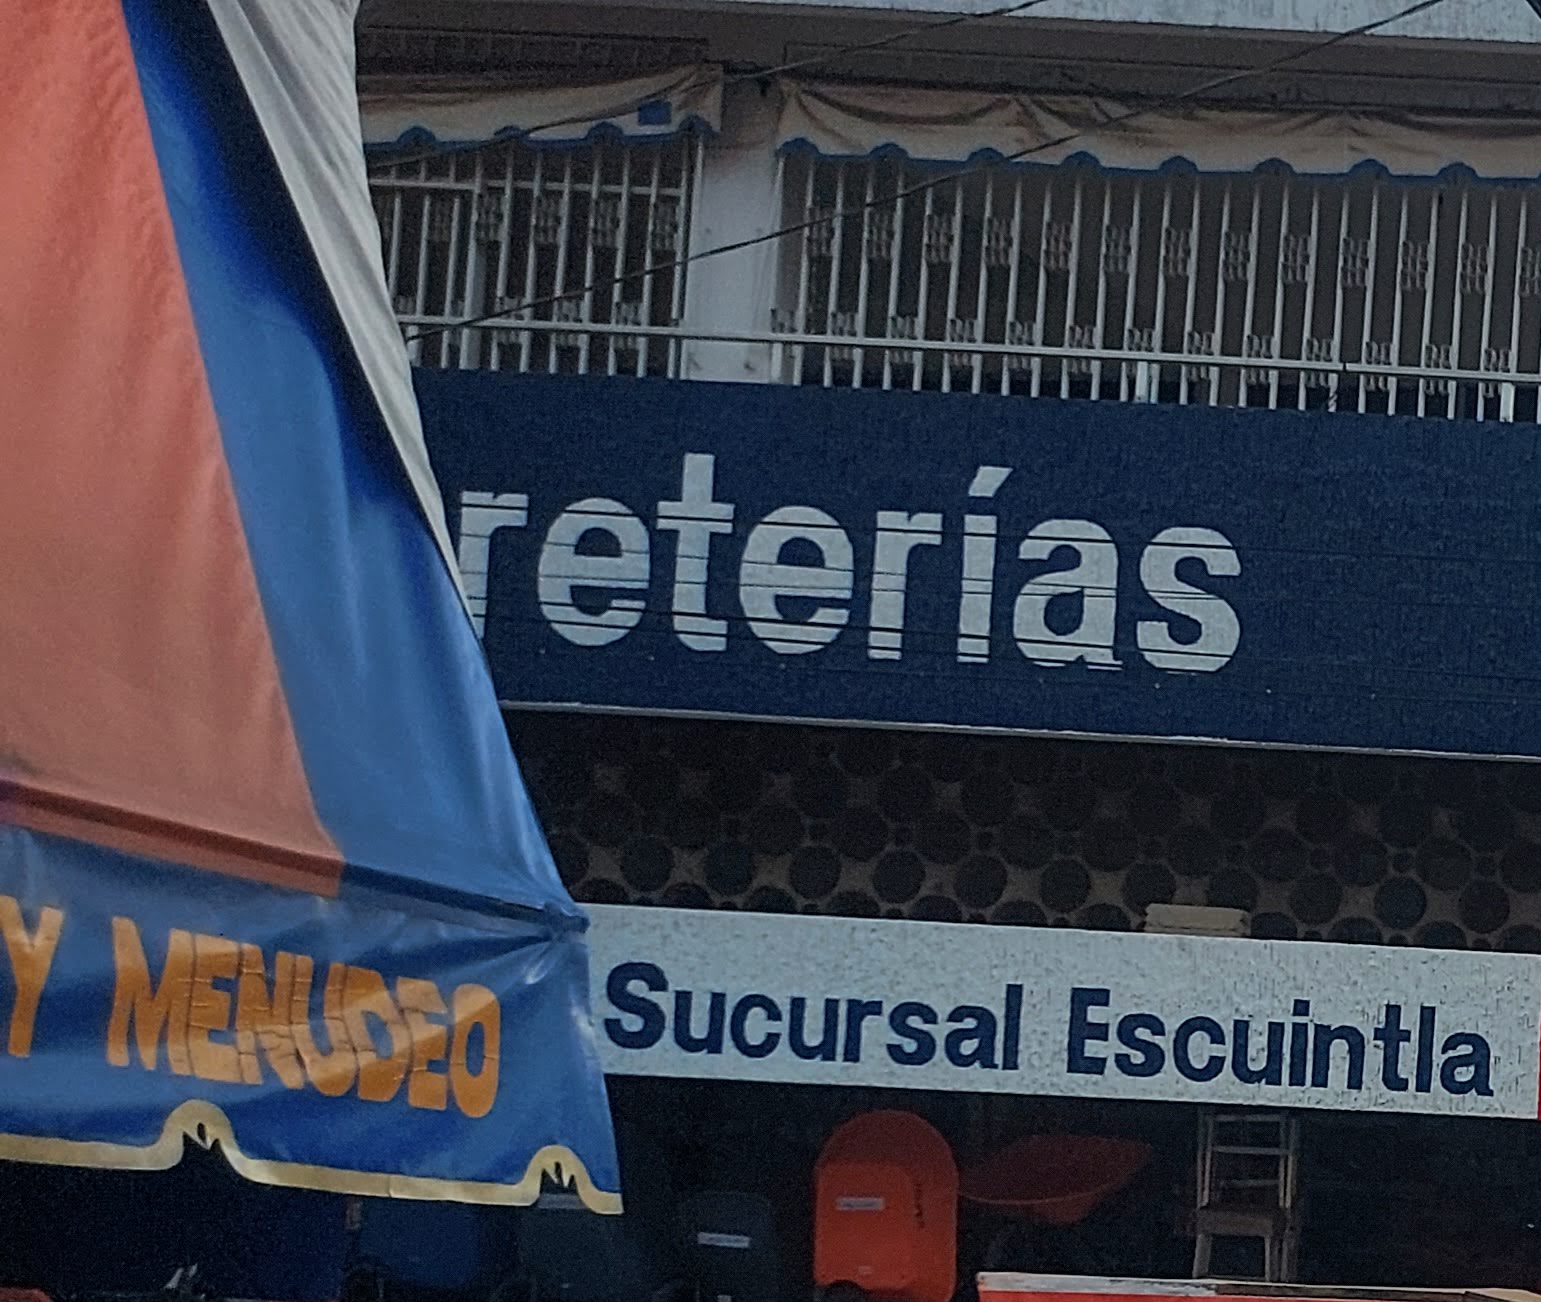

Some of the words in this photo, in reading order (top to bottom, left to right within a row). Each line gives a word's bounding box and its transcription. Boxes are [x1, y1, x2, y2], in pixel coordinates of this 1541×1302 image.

[0, 895, 65, 1058] Y
[106, 916, 501, 1118] MENUDEO
[603, 961, 1023, 1071] Sucursal
[1066, 987, 1495, 1097] Escuintla
